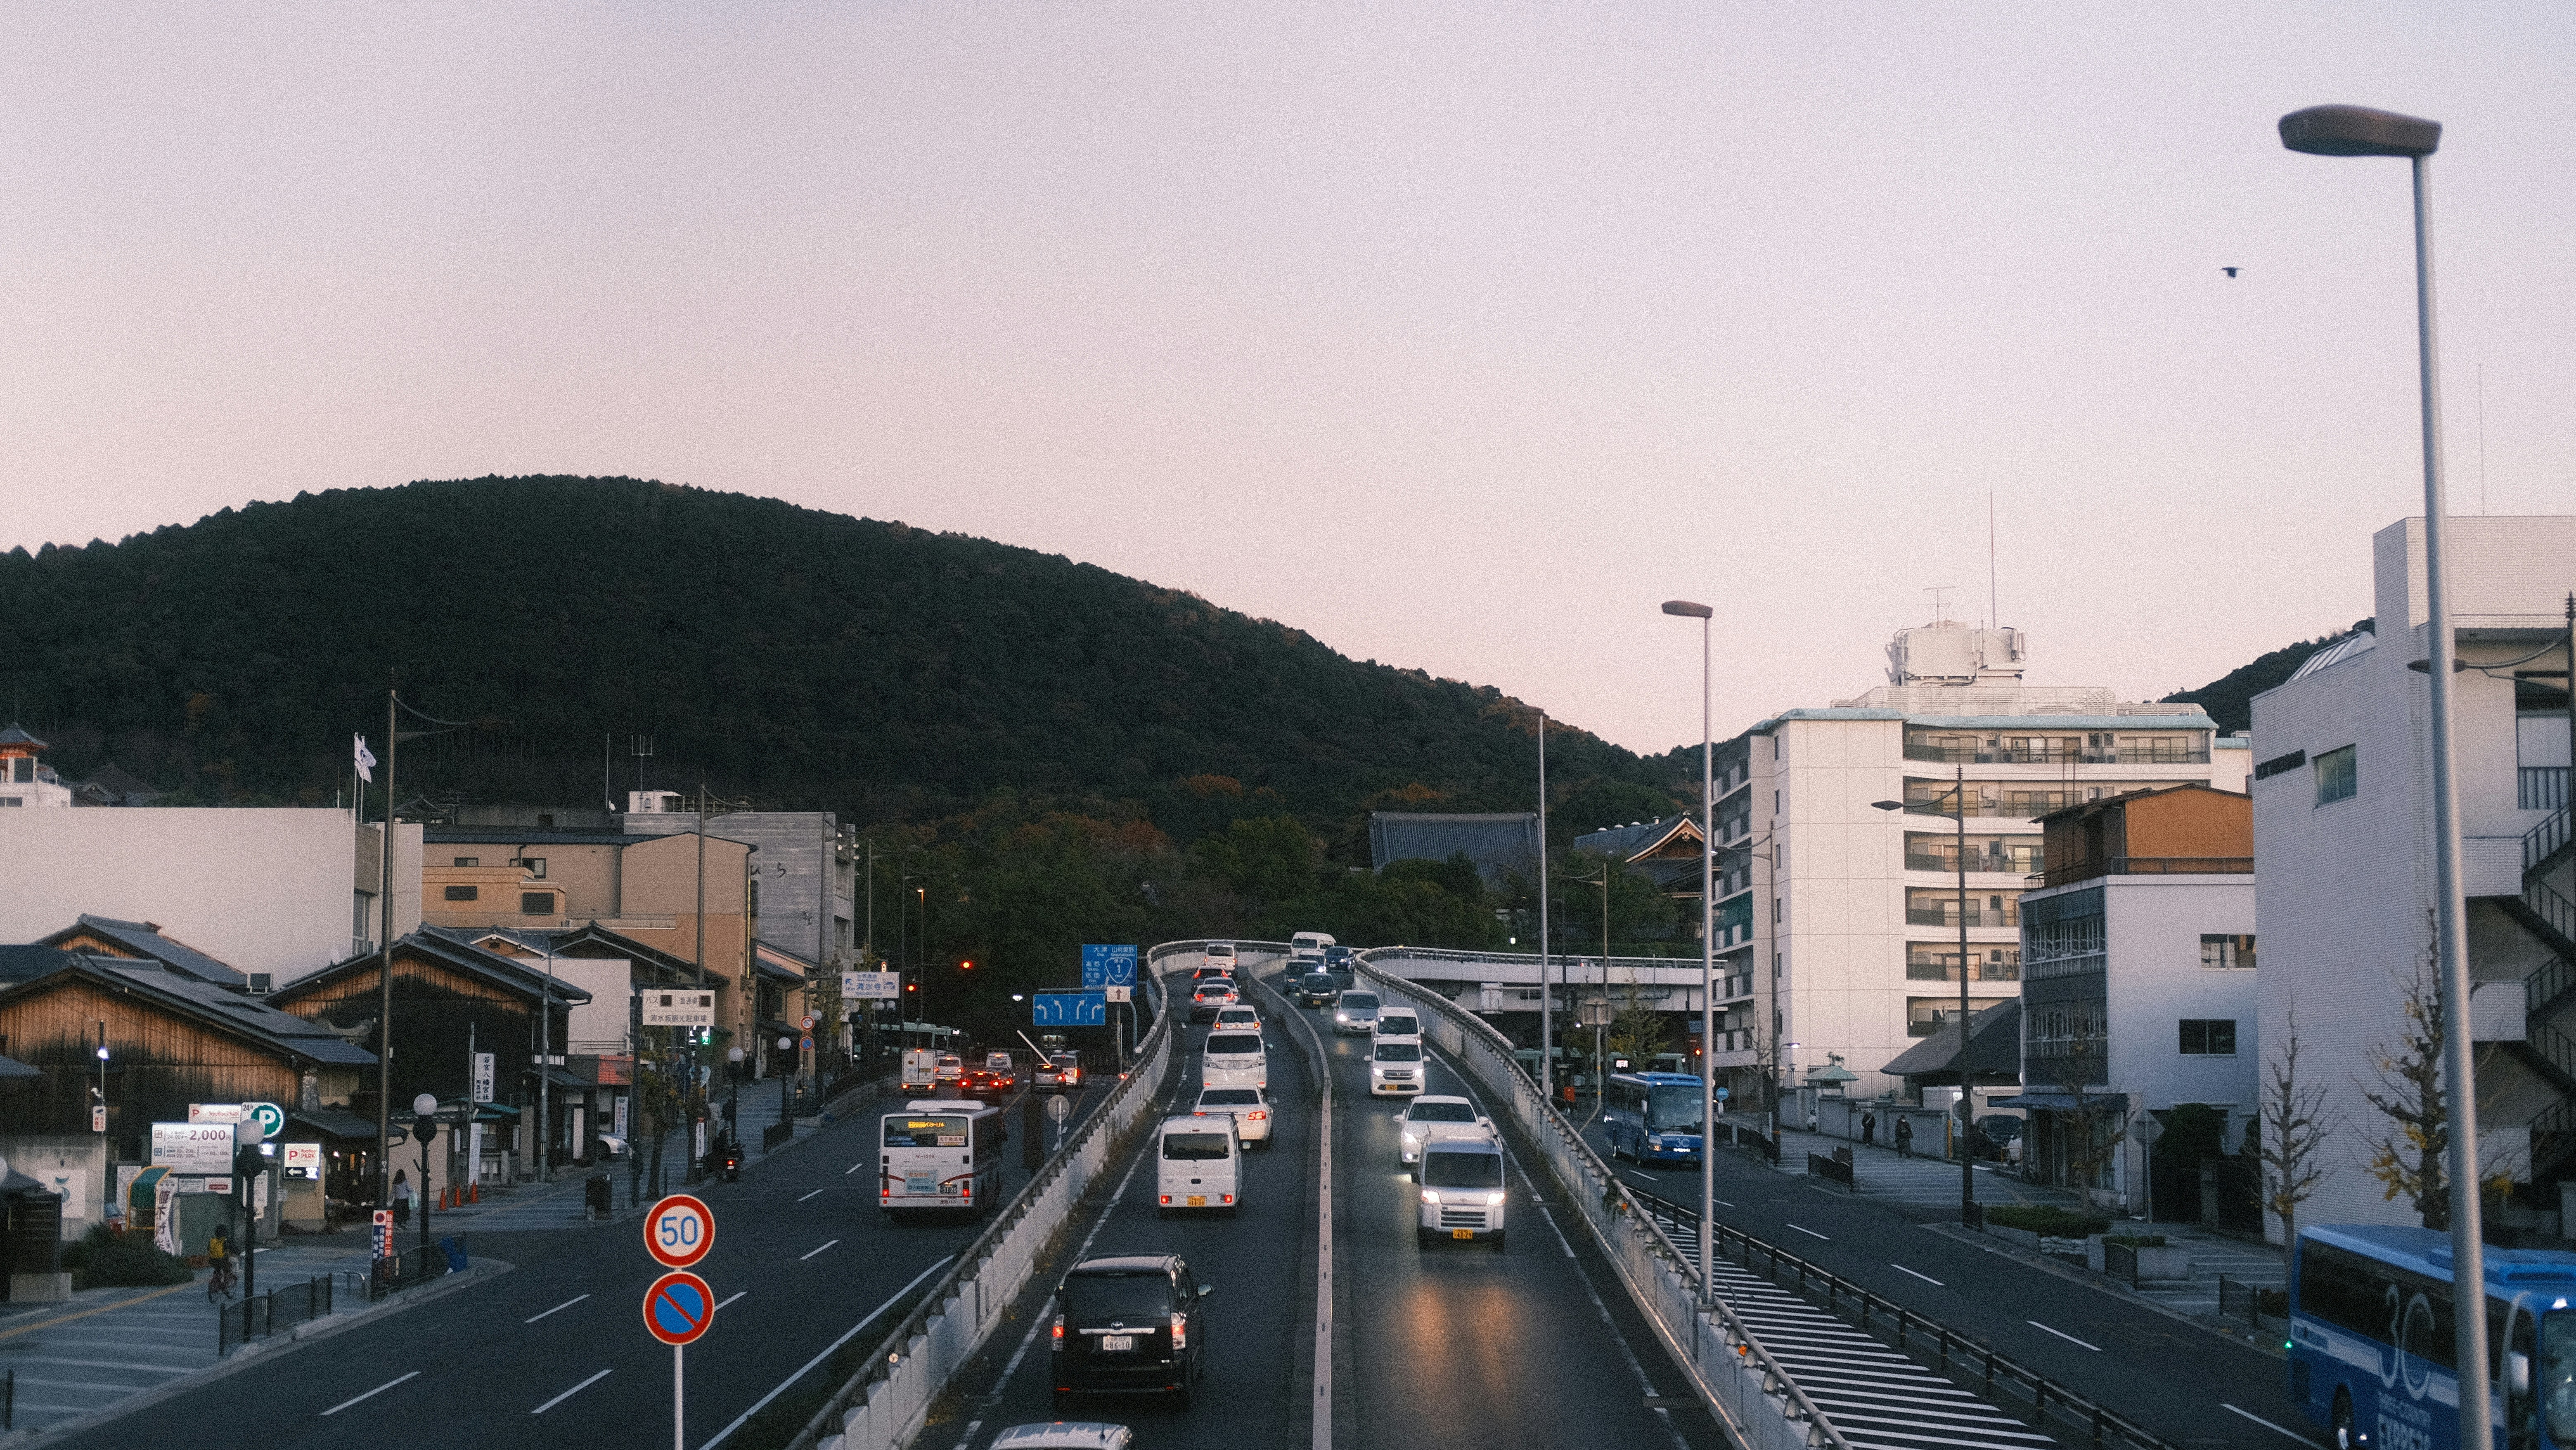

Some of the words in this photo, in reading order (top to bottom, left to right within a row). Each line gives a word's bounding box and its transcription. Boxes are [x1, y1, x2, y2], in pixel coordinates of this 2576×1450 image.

[1117, 964, 1120, 973] 1
[259, 1110, 276, 1133] P
[289, 1150, 298, 1160] P
[662, 1216, 698, 1246] 50
